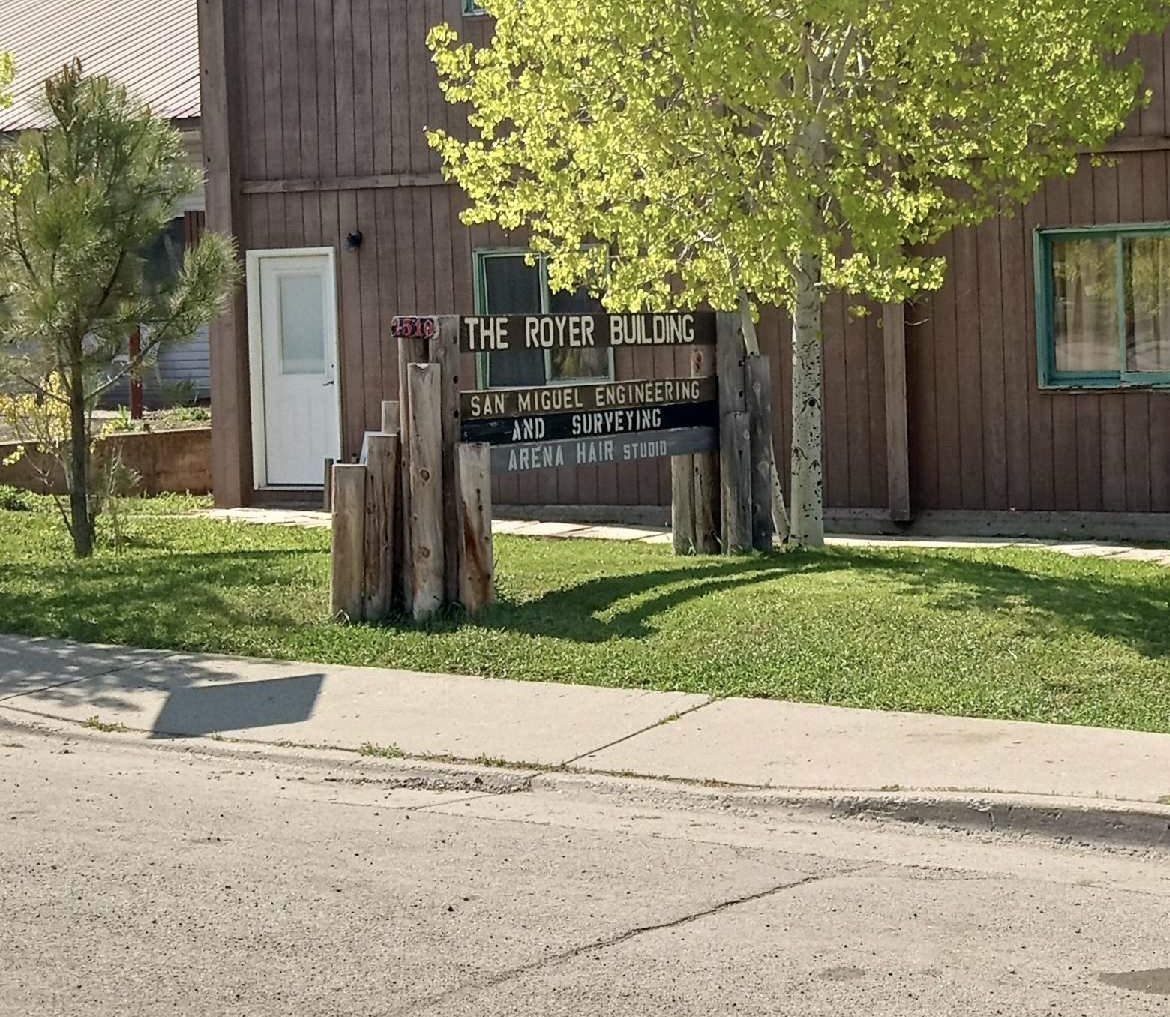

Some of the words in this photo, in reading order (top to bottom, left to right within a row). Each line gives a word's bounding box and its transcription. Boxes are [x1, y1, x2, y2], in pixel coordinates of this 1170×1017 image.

[464, 317, 509, 350] THE
[525, 315, 595, 348] ROYER
[610, 314, 695, 345] BUILDING
[471, 393, 505, 416] SAN
[518, 388, 584, 412] MIGUEL
[595, 381, 700, 407] ENGINEERING
[512, 417, 545, 441] AND
[572, 408, 661, 435] SURVEYING
[508, 445, 564, 471] ARENA
[576, 440, 614, 464] HAIR
[623, 440, 667, 460] STUDIO
